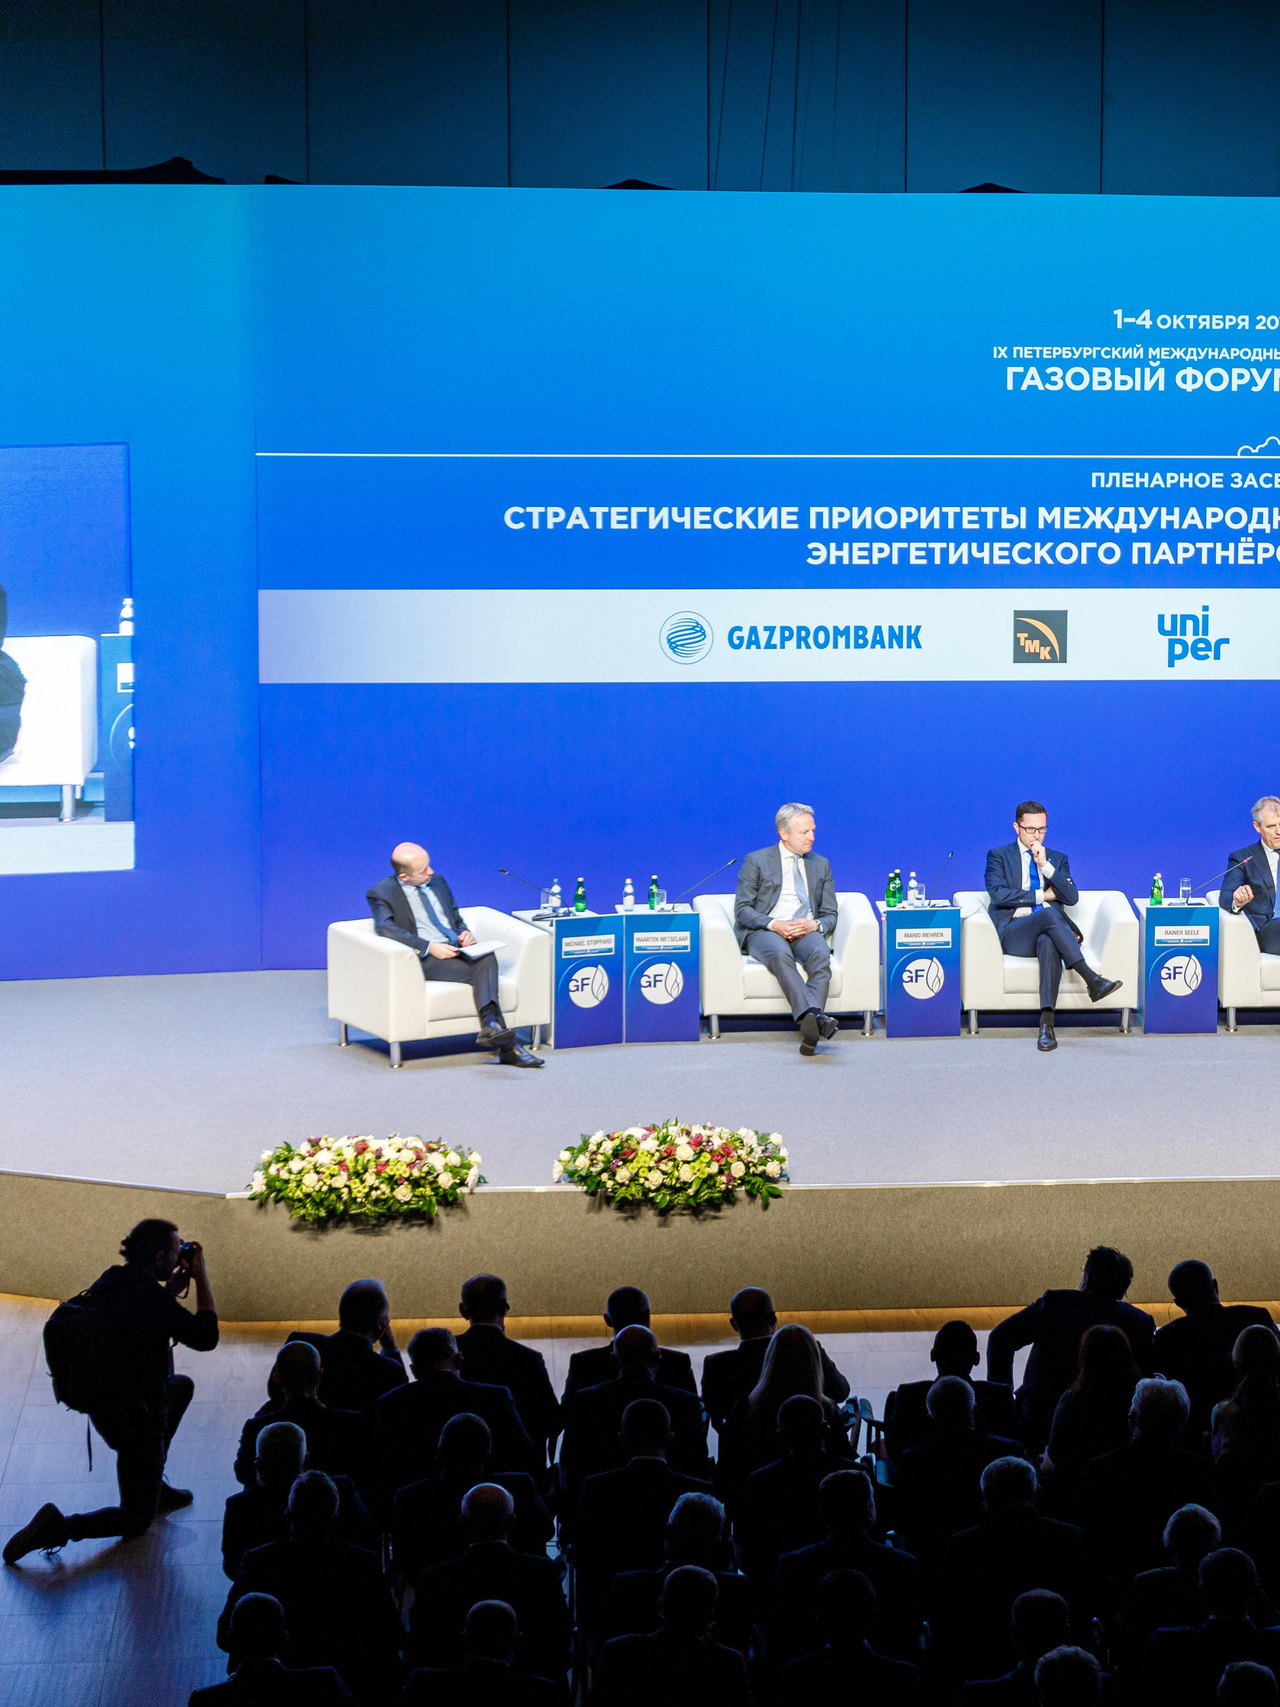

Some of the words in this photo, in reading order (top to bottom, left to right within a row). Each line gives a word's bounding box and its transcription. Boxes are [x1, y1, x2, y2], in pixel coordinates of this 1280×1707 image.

[1113, 308, 1153, 330] 1–4
[1156, 315, 1250, 331] ОКТЯБРЯ
[993, 346, 1008, 359] IX
[1013, 344, 1144, 360] ПЕТЕРБУРГСКИЙ
[1006, 361, 1165, 392] ГАЗОВЫЙ
[1091, 473, 1224, 489] ПЛЕНАРНОЕ
[503, 506, 799, 530] СТРАТЕГИЧЕСКИЕ
[809, 506, 1027, 530] ПРИОРИТЕТЫ
[806, 541, 1122, 566] ЭНЕРГЕТИЧЕСКОГО
[1157, 604, 1209, 636] uni
[727, 625, 922, 650] GAZPROMBANK
[1167, 637, 1230, 668] per
[586, 938, 613, 946] STOPPARD
[640, 973, 664, 989] GF
[902, 969, 925, 984] GF
[1160, 966, 1183, 980] GF
[568, 977, 591, 993] GF
